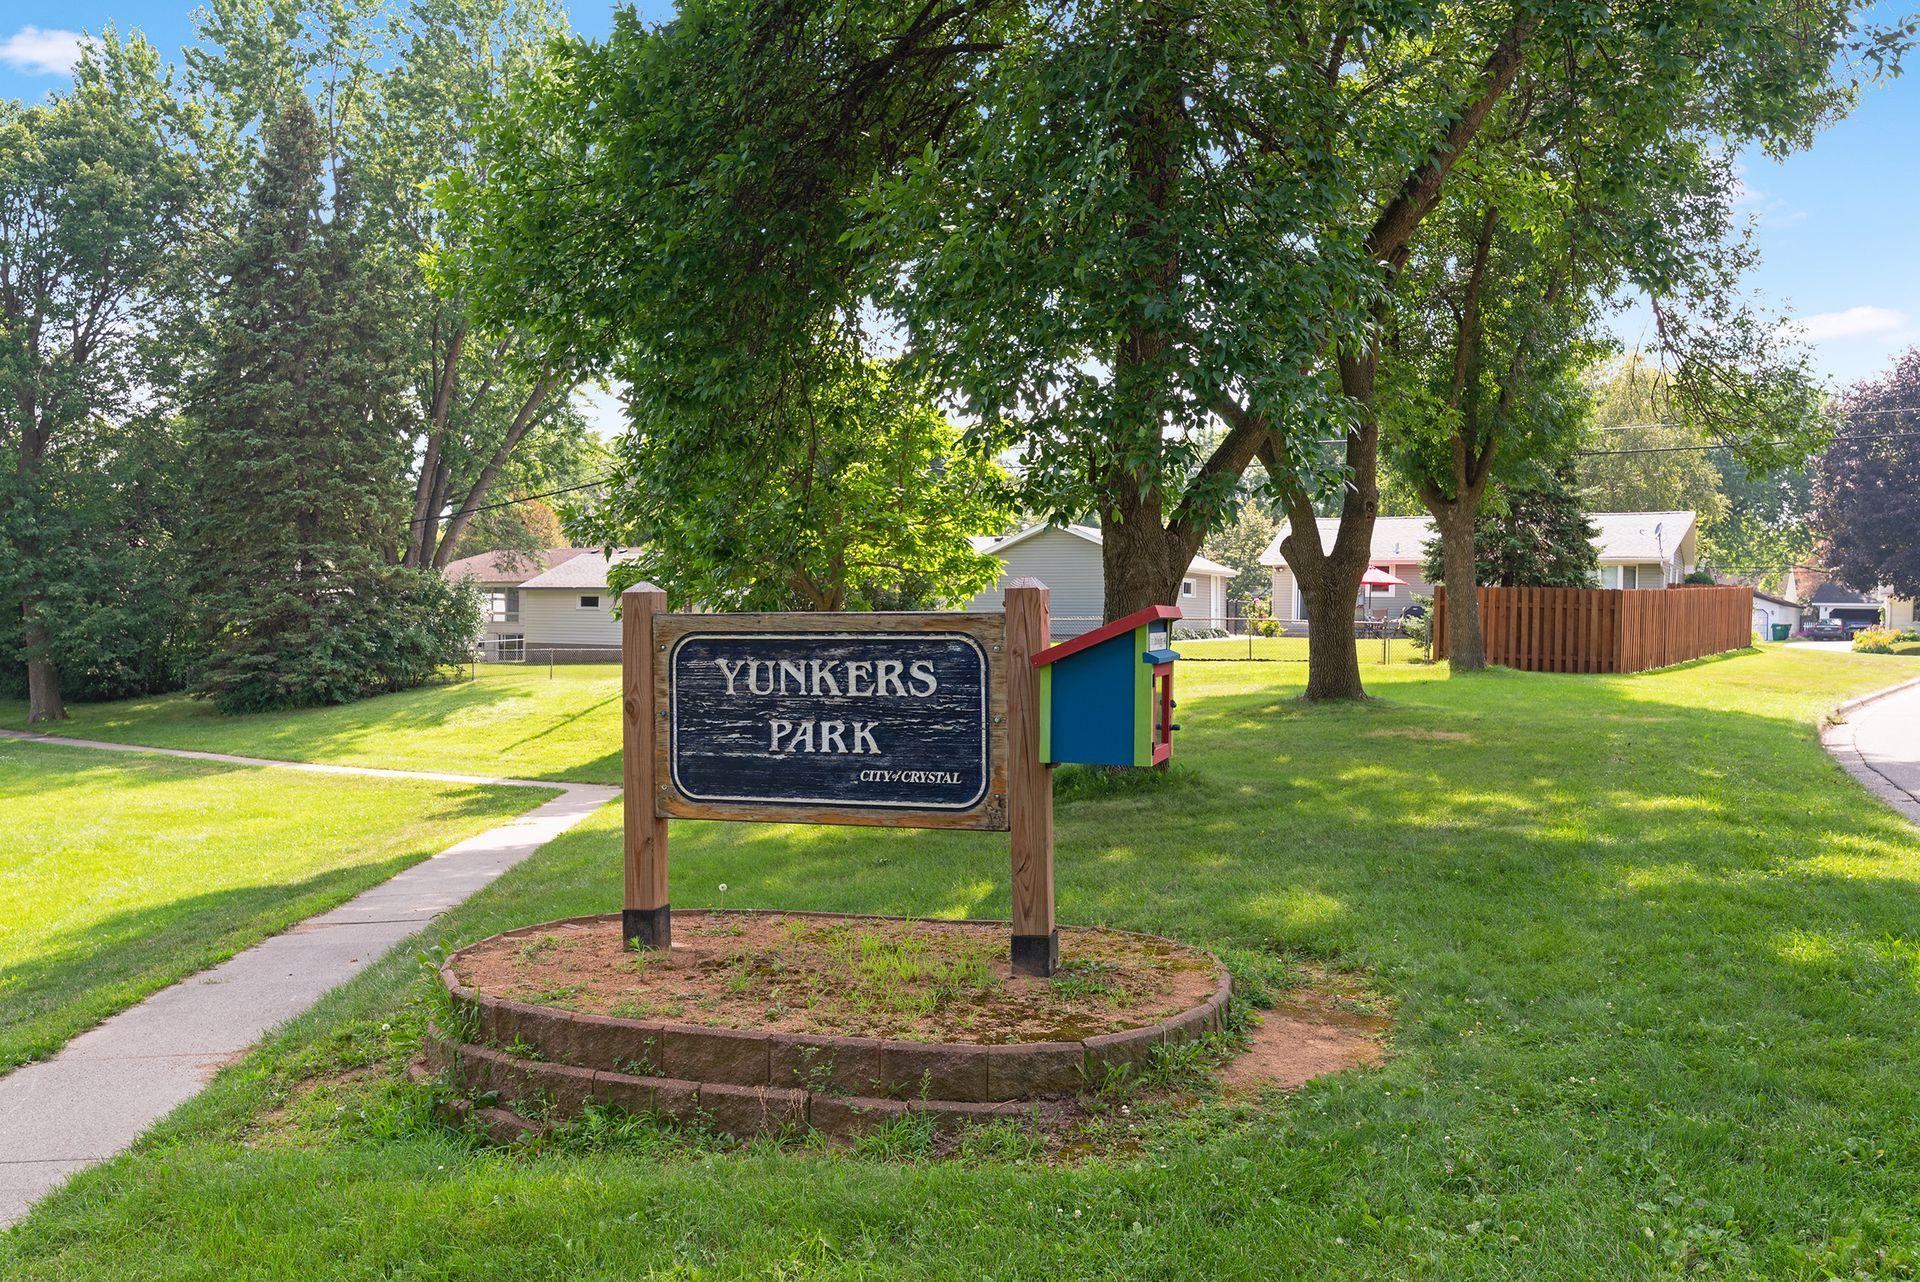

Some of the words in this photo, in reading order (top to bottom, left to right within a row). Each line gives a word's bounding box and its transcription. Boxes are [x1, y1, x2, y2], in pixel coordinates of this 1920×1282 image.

[714, 658, 938, 697] YUNKERS
[769, 719, 881, 754] PARK
[860, 770, 893, 782] CITY
[901, 771, 962, 784] CRYSTAL
